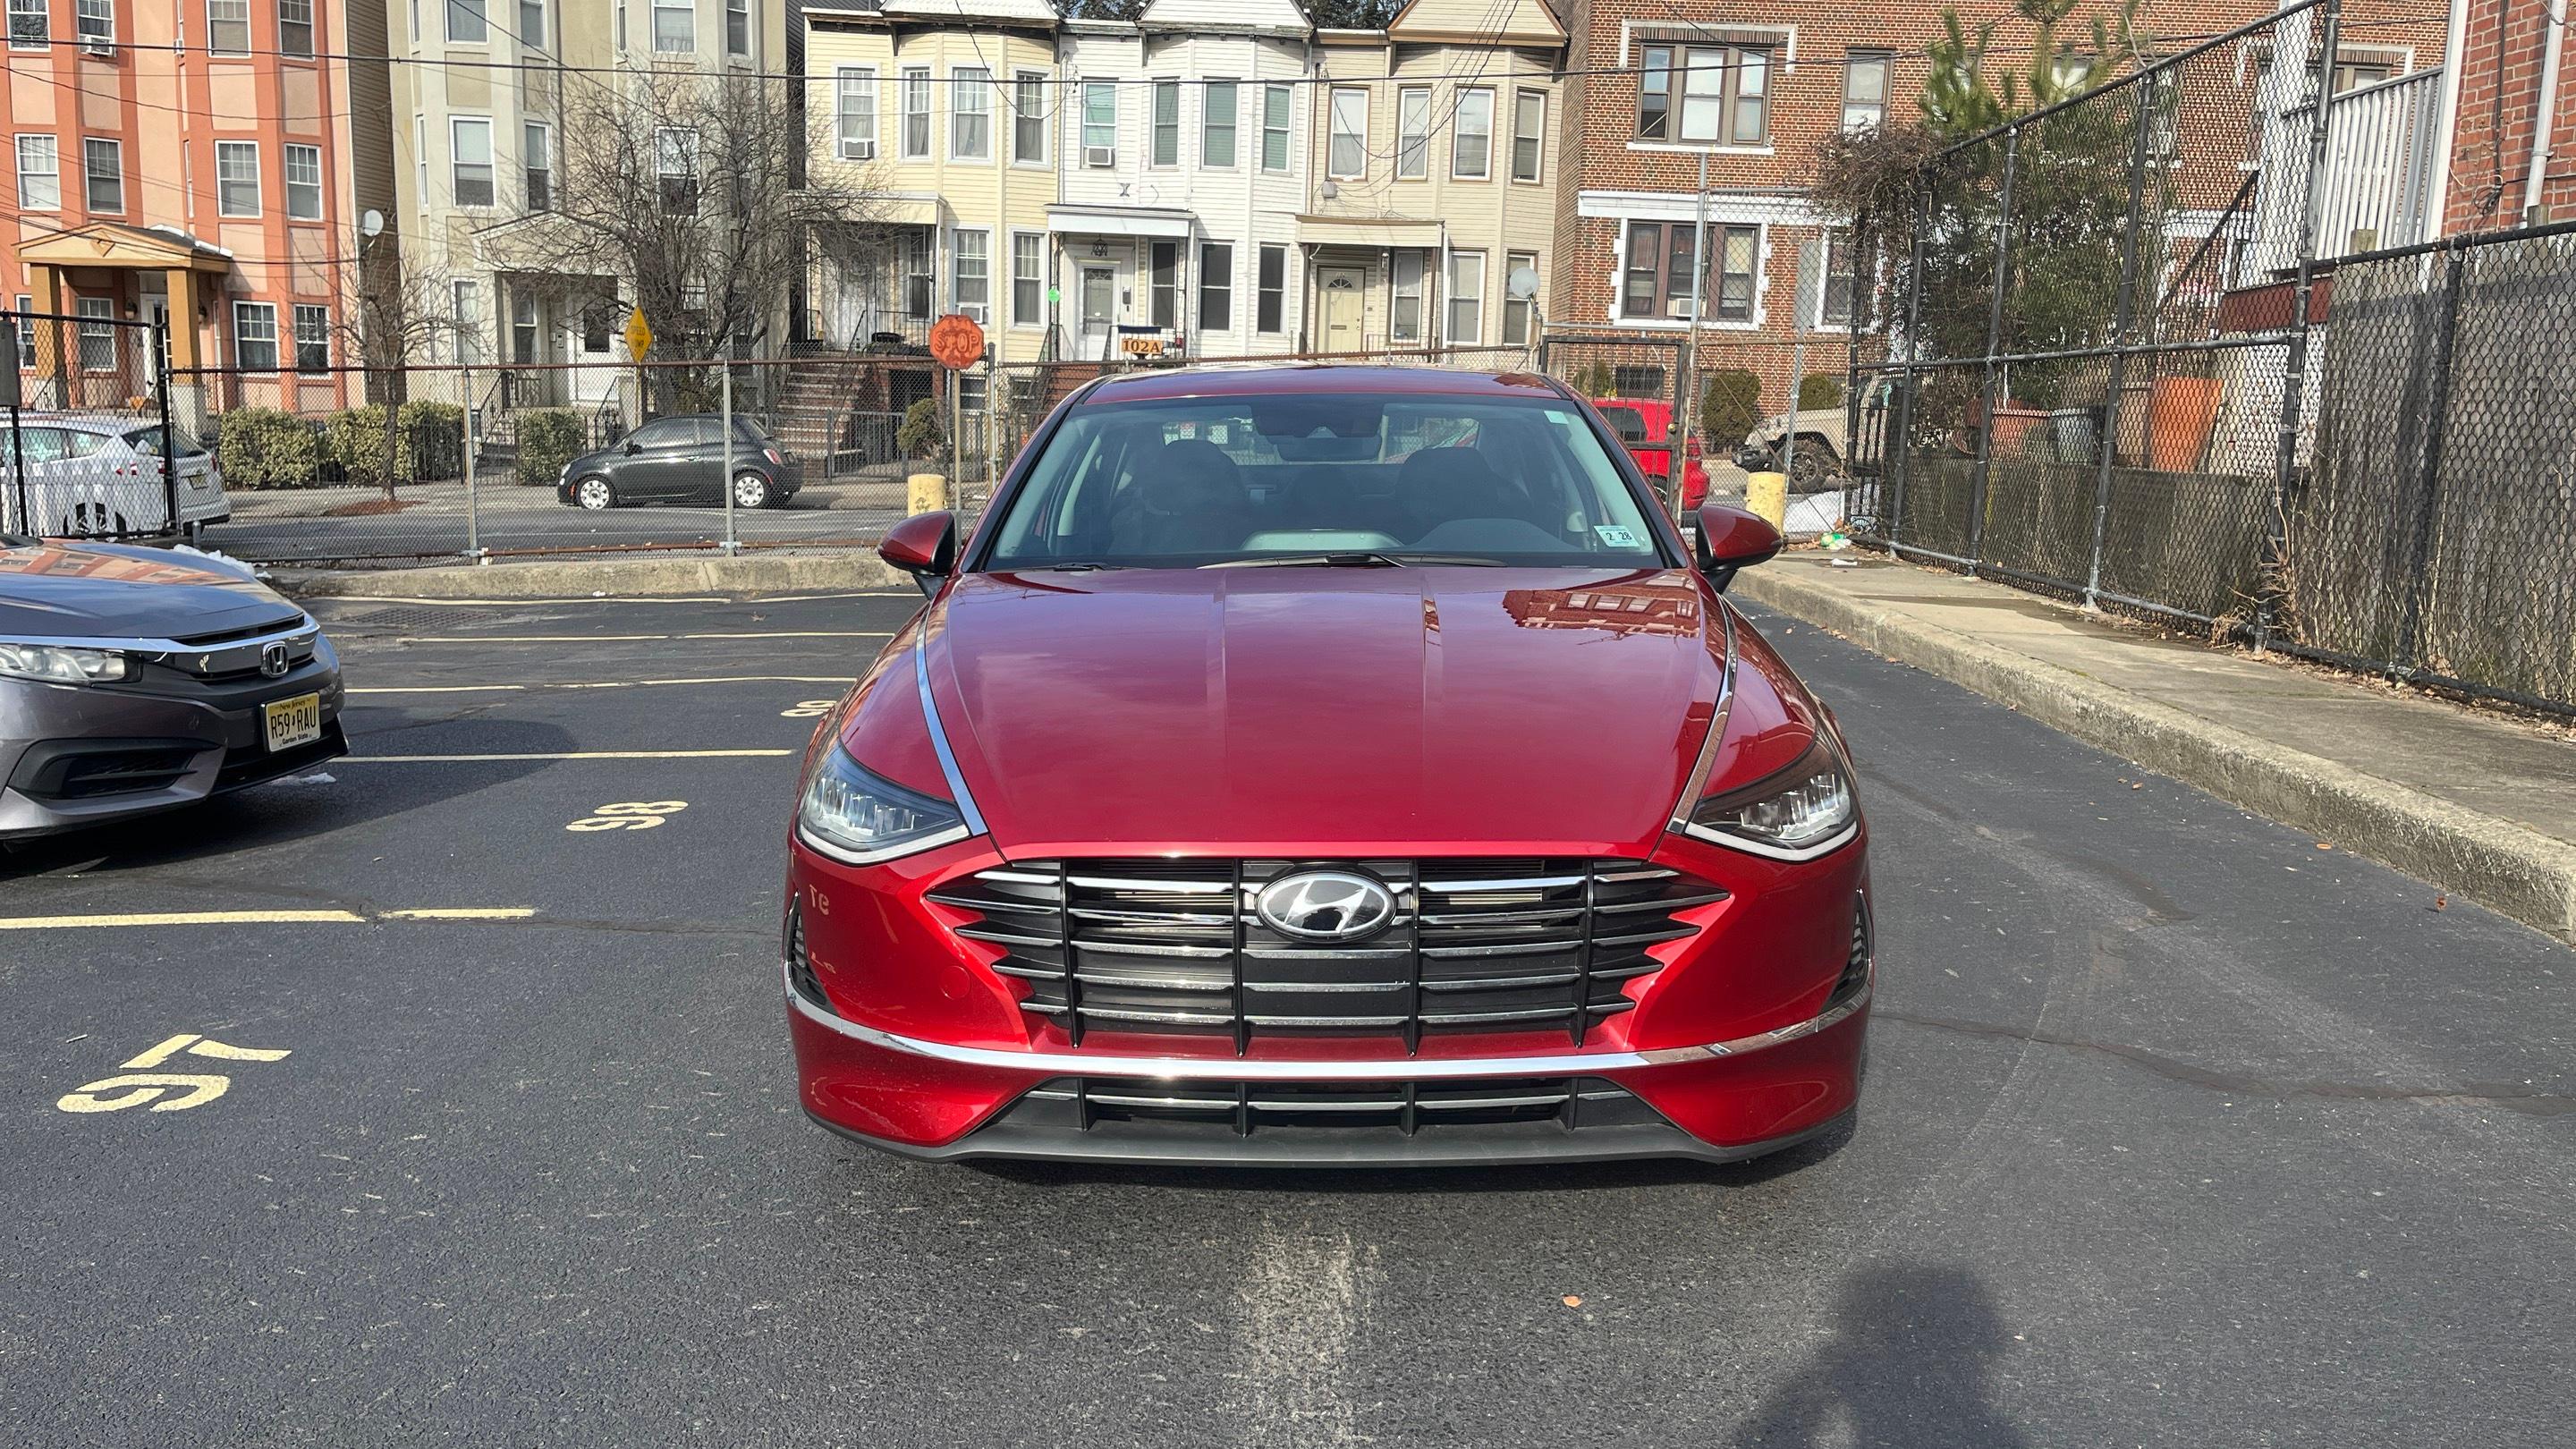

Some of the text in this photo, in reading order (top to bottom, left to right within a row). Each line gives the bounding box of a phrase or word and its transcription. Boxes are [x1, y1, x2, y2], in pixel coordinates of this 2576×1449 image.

[934, 331, 979, 352] STOP
[1123, 341, 1160, 352] 102A
[1606, 532, 1614, 541] 2
[565, 801, 689, 832] 98
[55, 1034, 292, 1113] 97
